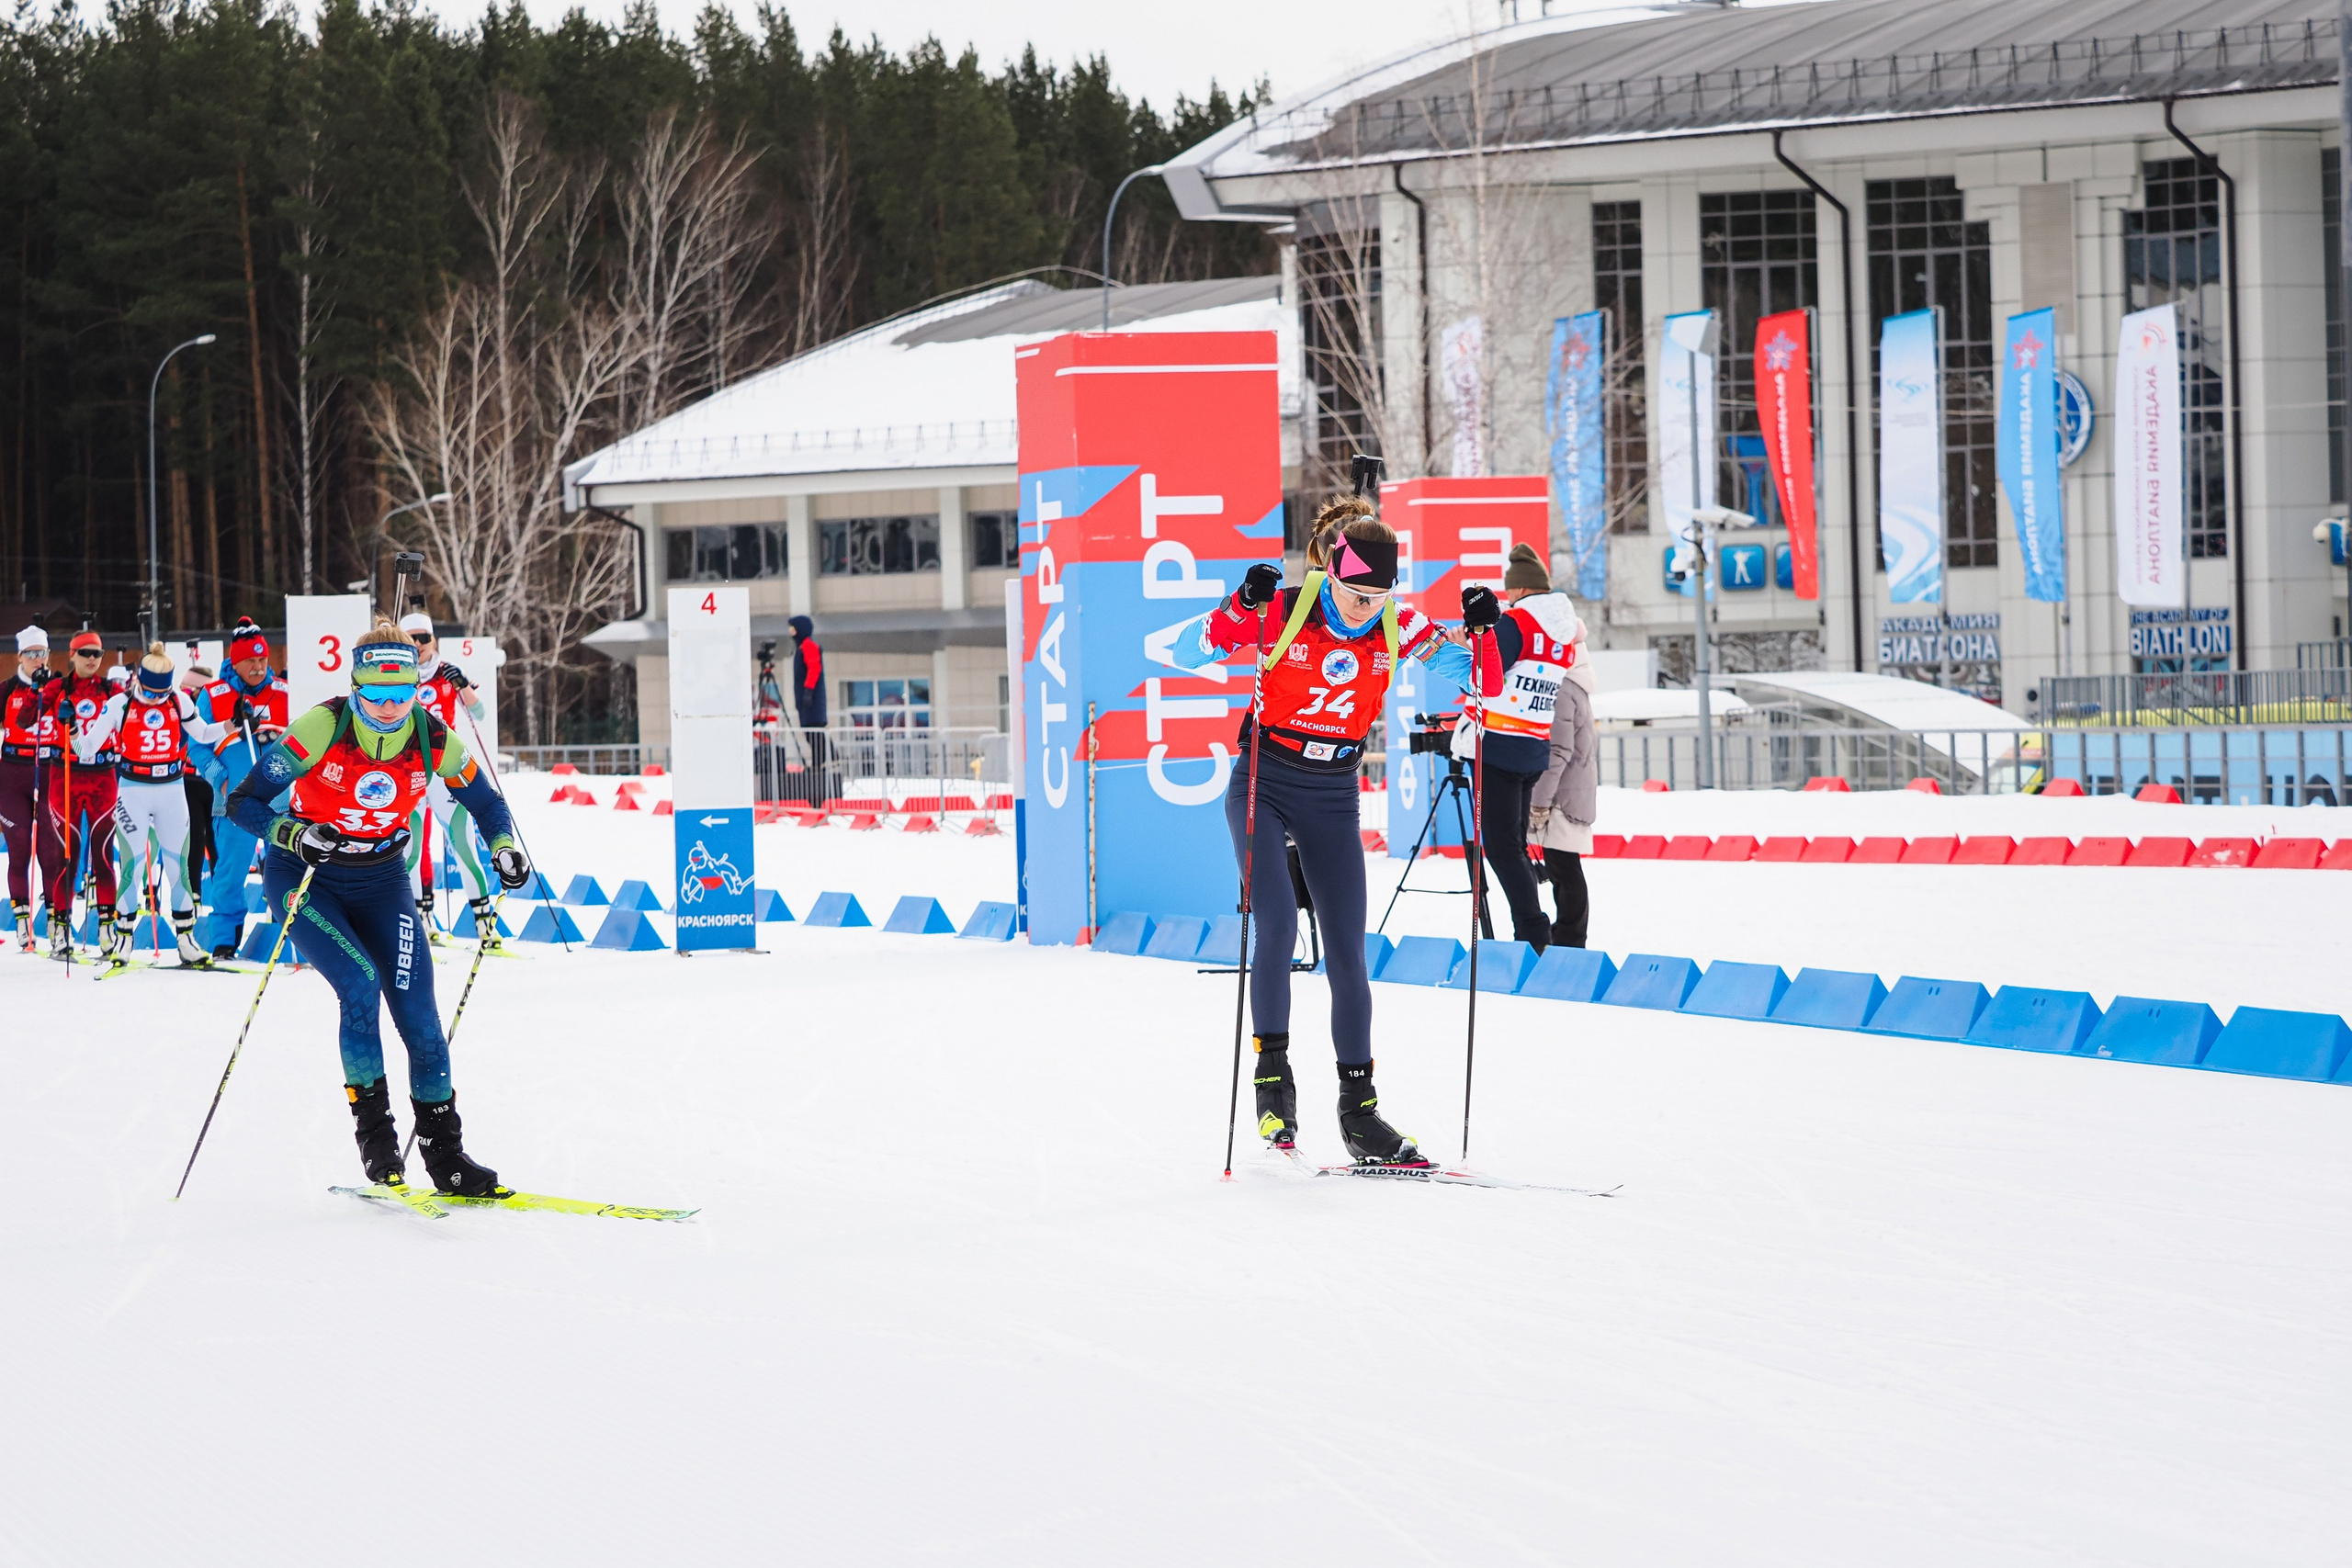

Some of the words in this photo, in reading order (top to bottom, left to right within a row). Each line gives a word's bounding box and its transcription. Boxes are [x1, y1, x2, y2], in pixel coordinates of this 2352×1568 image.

[701, 592, 717, 615] 4
[2153, 609, 2207, 623] ACADMY
[462, 640, 473, 657] 5
[1036, 480, 1069, 809] СТАРТ
[1140, 473, 1231, 807] СТАРТ
[2131, 625, 2227, 656] BIATHLON
[318, 635, 342, 671] 3
[1397, 529, 1418, 810] ФИНШ
[1296, 686, 1356, 719] 34
[1289, 718, 1347, 735] КРАСНОЯРСК
[140, 728, 172, 753] 35
[335, 807, 400, 831] 33
[301, 905, 376, 981] БЕЛОРУСНЕФТЬ
[397, 913, 414, 970] BEEU
[1253, 1076, 1282, 1085] SCHER
[1348, 1069, 1365, 1078] 184
[432, 1104, 449, 1114] 183
[1351, 1168, 1430, 1179] MADSHUS
[617, 1206, 687, 1218] FISCHER
